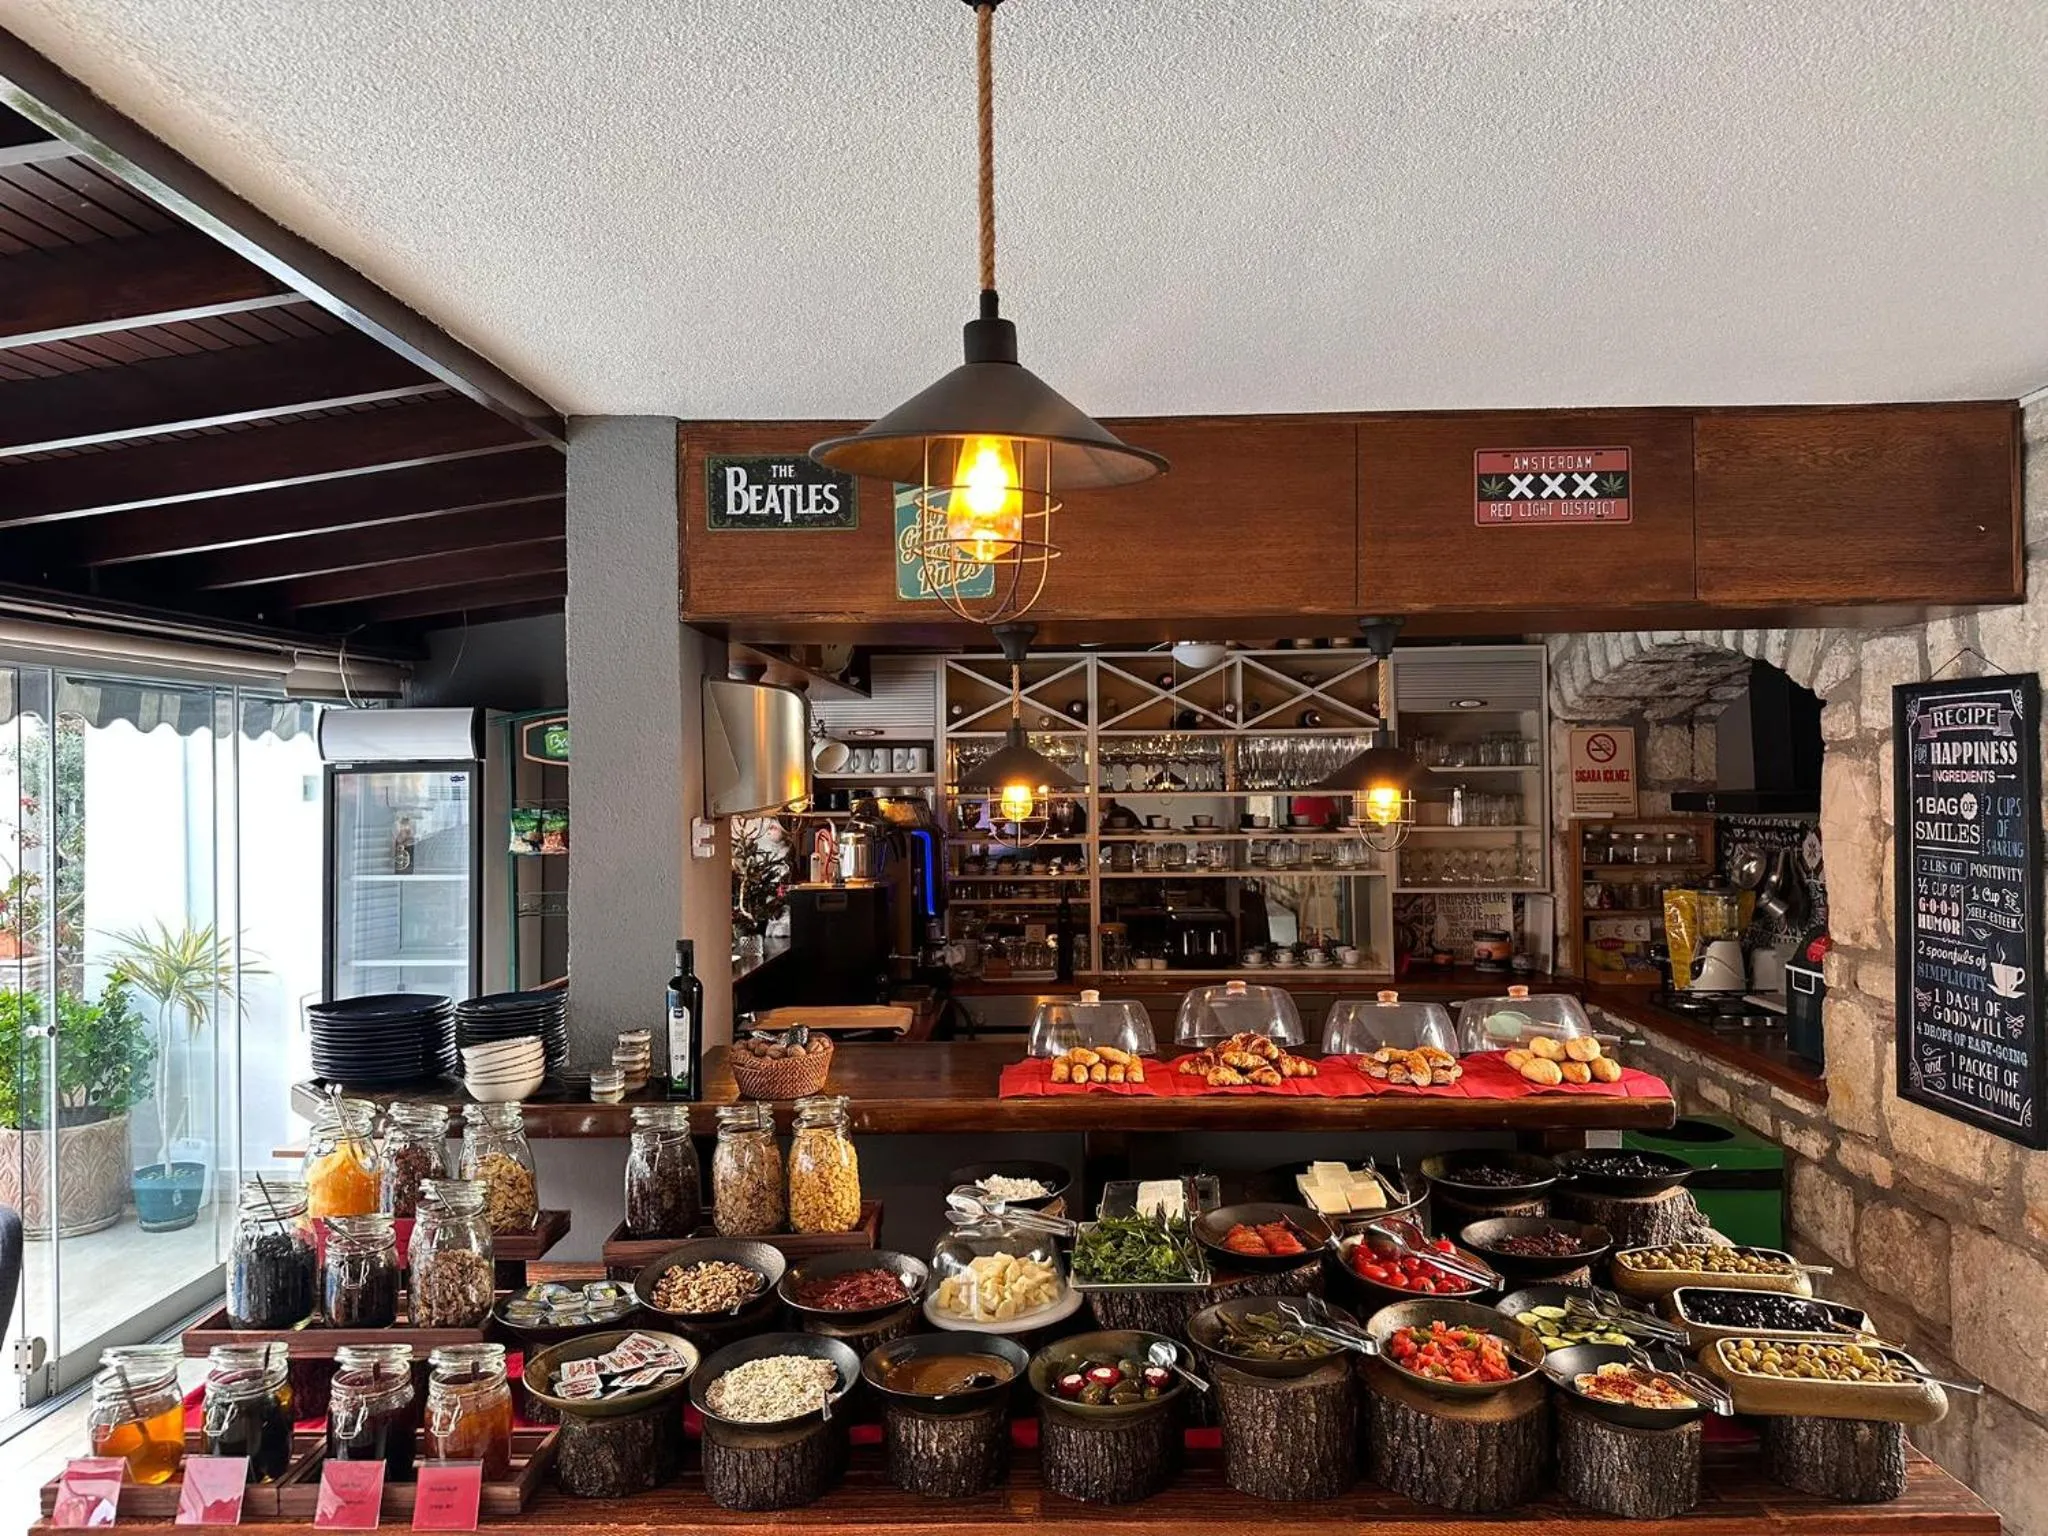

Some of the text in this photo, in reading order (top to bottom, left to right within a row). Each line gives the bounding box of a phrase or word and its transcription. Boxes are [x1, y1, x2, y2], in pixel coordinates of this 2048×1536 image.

[771, 465, 795, 478] THE
[1513, 455, 1592, 471] AMSTERDAM
[725, 466, 840, 523] BEATLES
[1490, 500, 1617, 517] RED LIGHT DISTRICT
[1933, 707, 1996, 727] RECIPE
[1930, 740, 2018, 765] HAPPINESS
[1932, 769, 1996, 783] INGREDIENTS
[1916, 796, 1975, 815] 1 BAG OF
[1985, 795, 2022, 817] 2 CUPS
[1915, 821, 1981, 844] SMILES
[1997, 819, 2010, 838] OF
[1986, 839, 2024, 858] SHARING
[1921, 859, 1963, 875] 2 LBS OF
[1969, 862, 2024, 882] POSITIVITY
[1931, 881, 1948, 897] CUP
[1949, 883, 1961, 898] OF
[1918, 912, 1961, 936] HUMOR
[1918, 940, 1988, 972] 2 spoonfuls of
[1916, 962, 1987, 992] SIMPLICITY
[1934, 987, 2001, 1018] 1 DASH OF
[1932, 1004, 2006, 1040] GOODWILL
[1916, 1021, 2029, 1068] 4 DROPS OF EASY-GOING
[1924, 1057, 1943, 1074] and
[1950, 1051, 2020, 1089] 1 PACKET OF
[1952, 1072, 2021, 1111] LIFE LOVING
